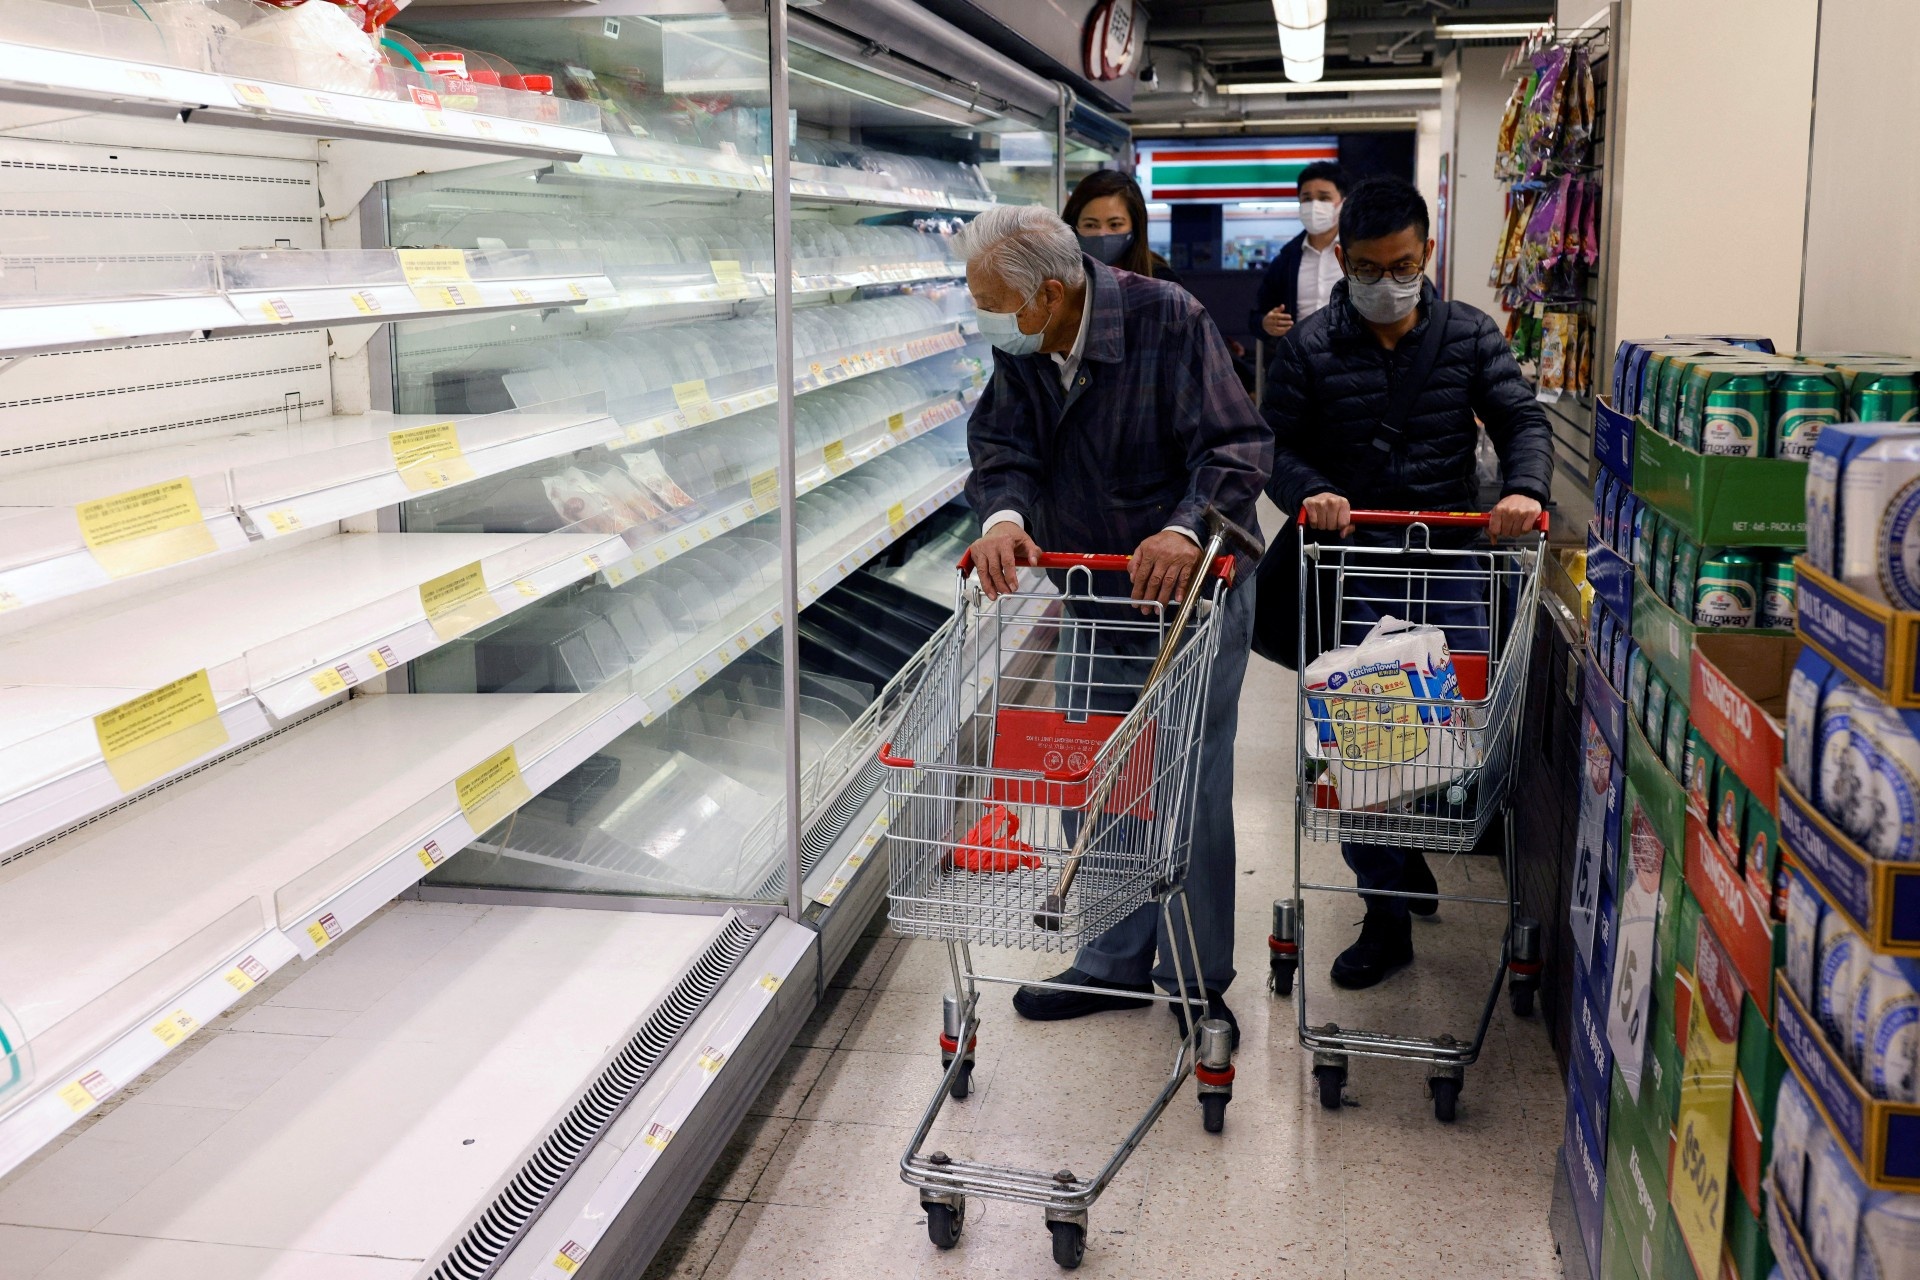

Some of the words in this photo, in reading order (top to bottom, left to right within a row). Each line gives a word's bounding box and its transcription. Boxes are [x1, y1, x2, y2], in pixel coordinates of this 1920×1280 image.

[1702, 441, 1752, 457] ingway
[1780, 441, 1814, 459] King
[1733, 522, 1748, 531] NET
[1771, 522, 1791, 531] PACK
[1699, 662, 1752, 740] TSINGTAO
